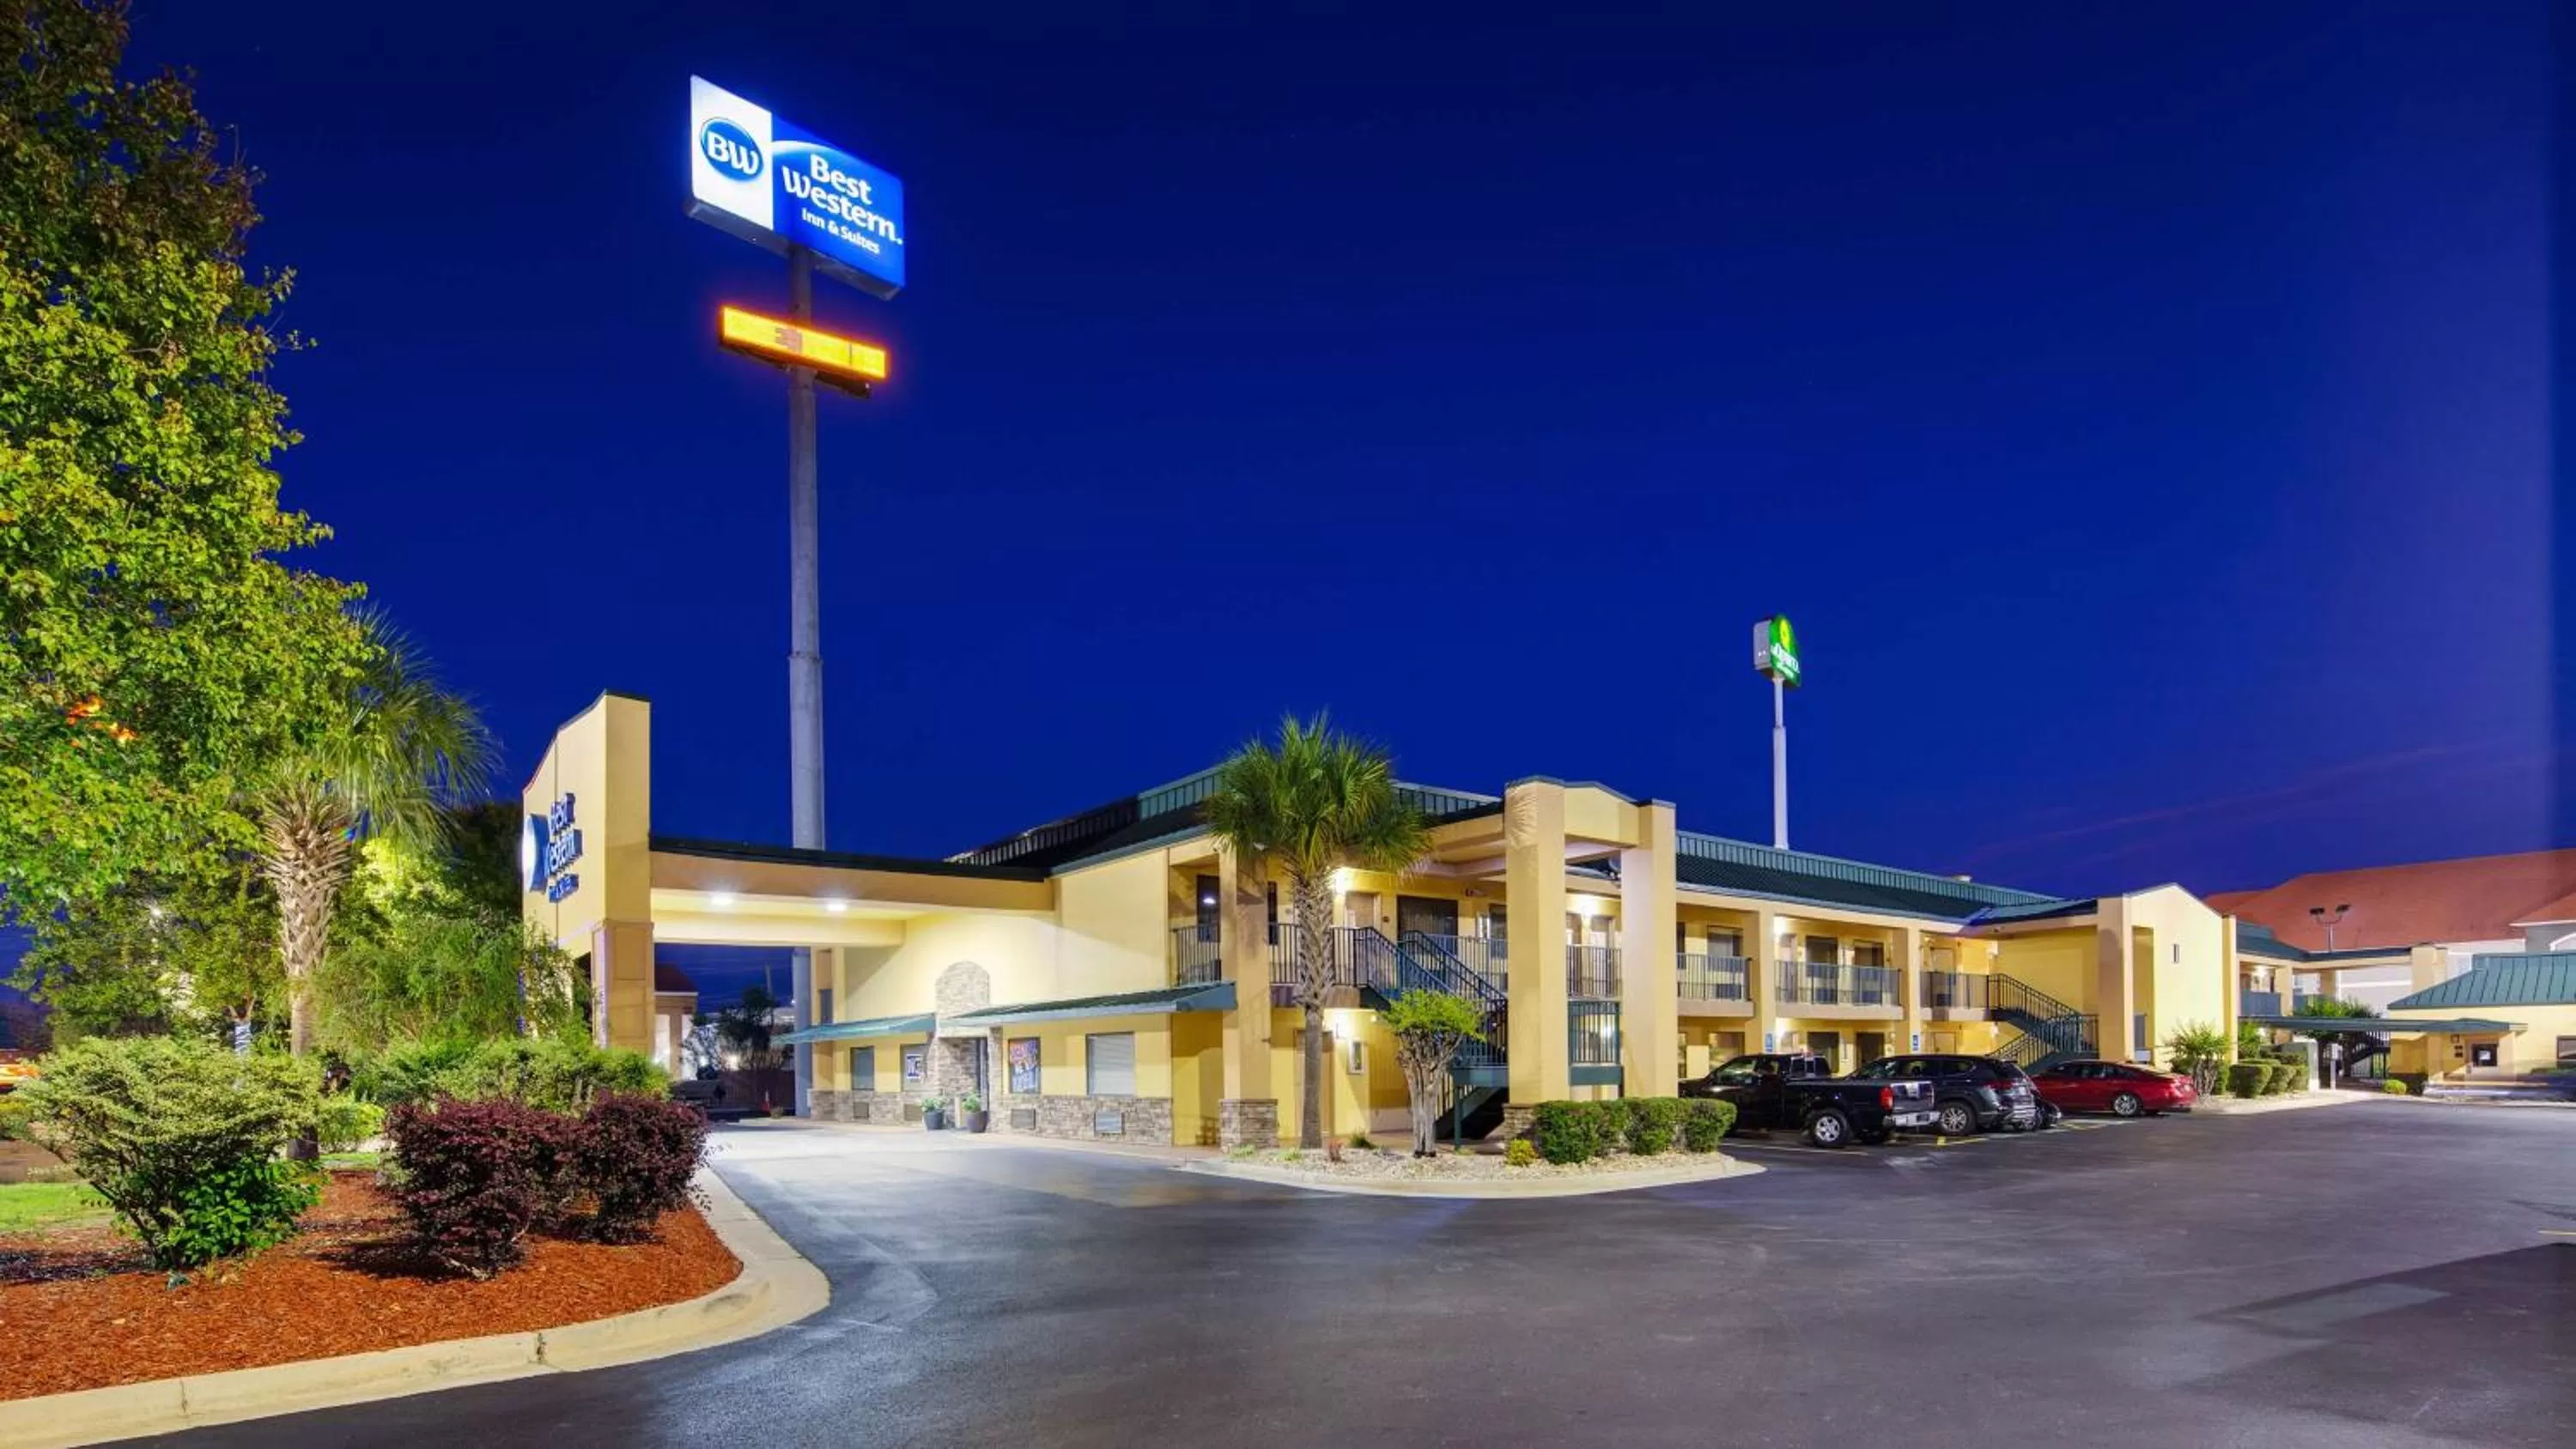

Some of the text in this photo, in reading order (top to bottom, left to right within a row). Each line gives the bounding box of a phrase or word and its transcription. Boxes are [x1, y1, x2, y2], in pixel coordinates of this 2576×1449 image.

[707, 130, 759, 175] BW
[811, 154, 872, 205] Best
[801, 207, 880, 255] Inn & Suites
